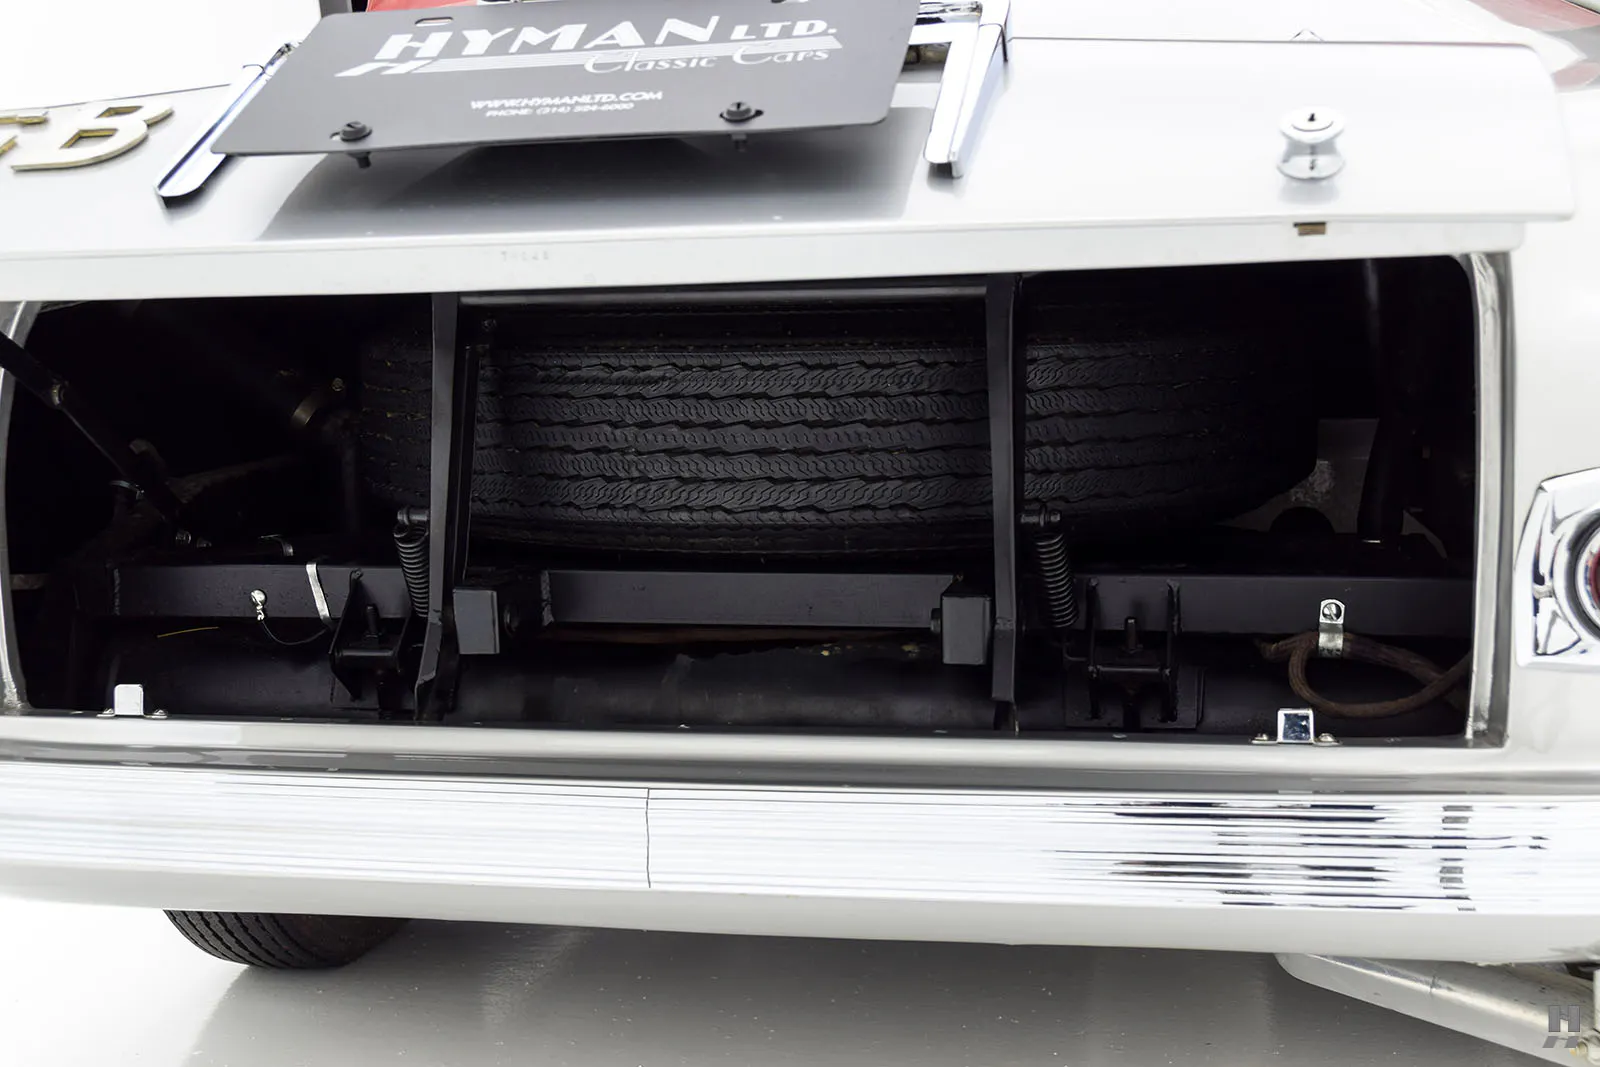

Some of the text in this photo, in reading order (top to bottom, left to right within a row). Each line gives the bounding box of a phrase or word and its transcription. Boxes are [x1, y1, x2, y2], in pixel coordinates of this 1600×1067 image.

[373, 16, 838, 60] HYMAN LTD.
[584, 46, 830, 74] Classic Cars
[470, 91, 664, 110] WWW.HYMANLTD.COM
